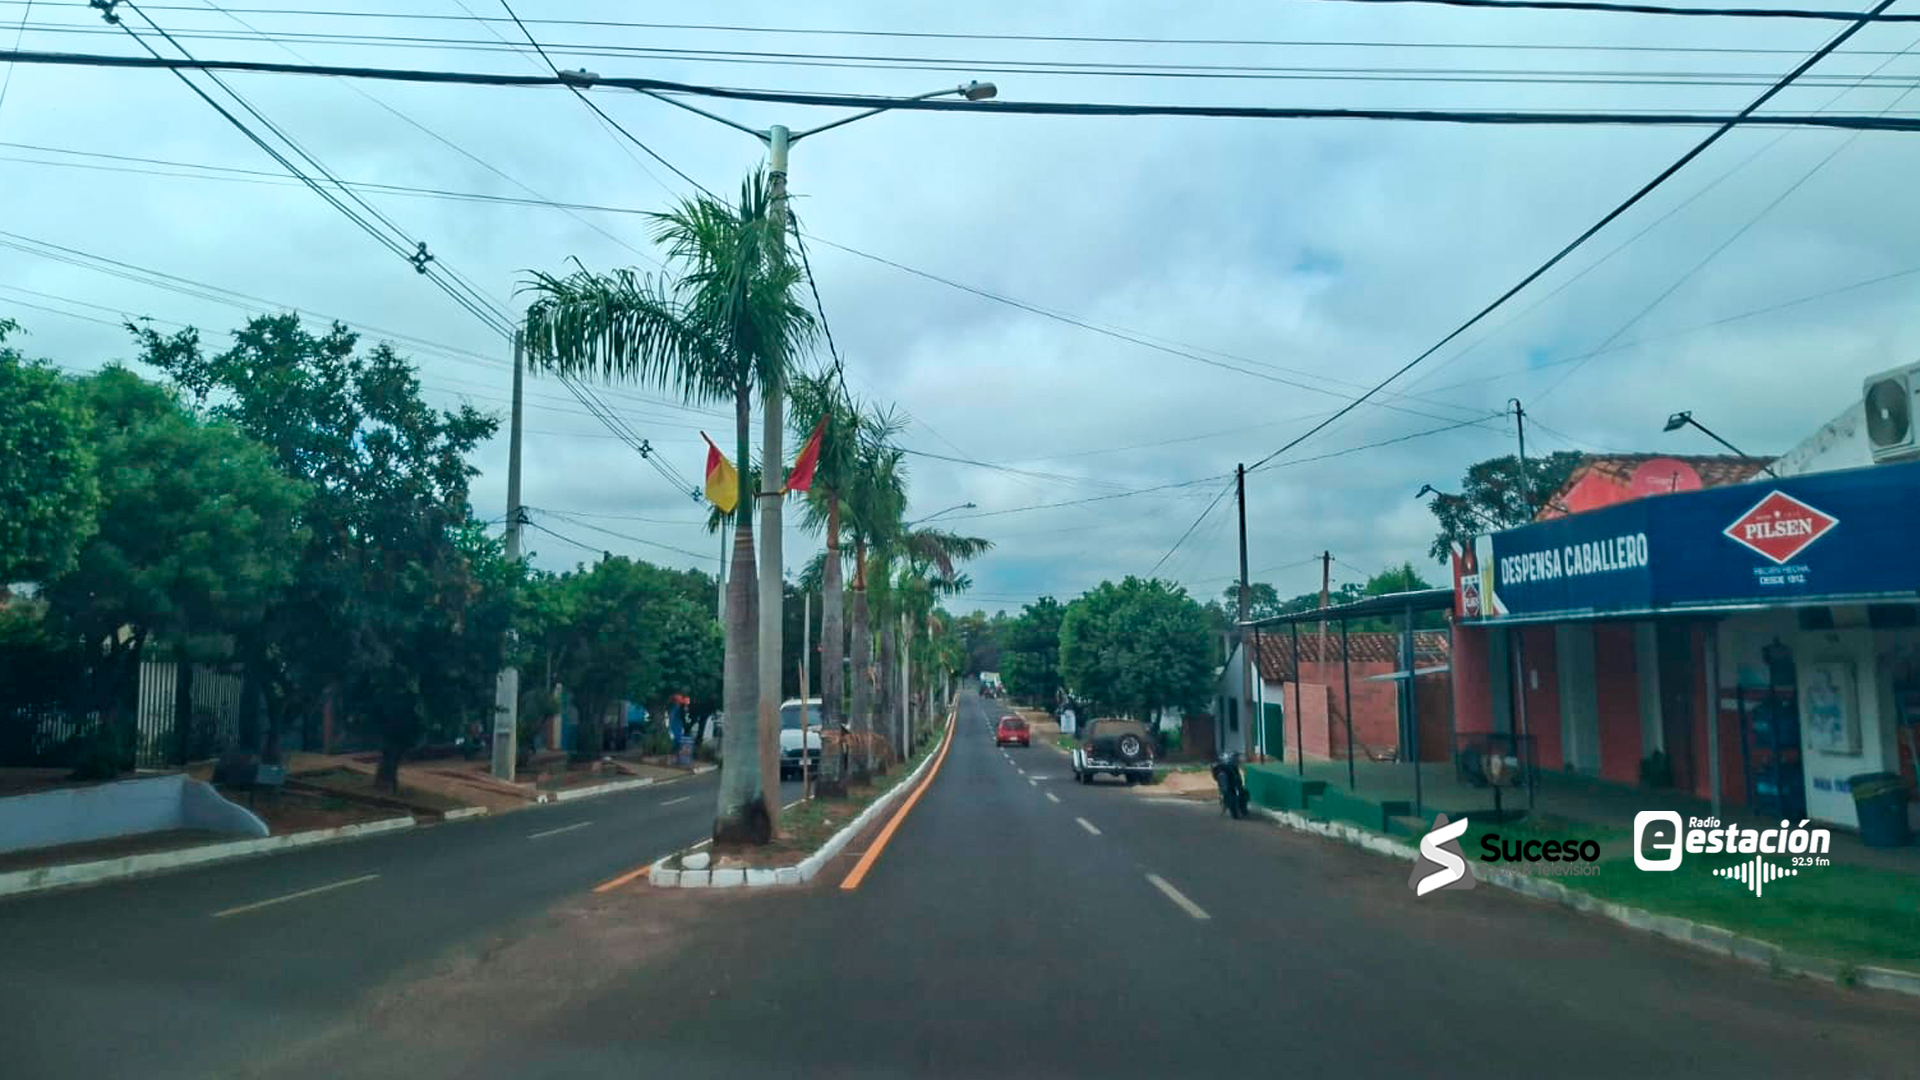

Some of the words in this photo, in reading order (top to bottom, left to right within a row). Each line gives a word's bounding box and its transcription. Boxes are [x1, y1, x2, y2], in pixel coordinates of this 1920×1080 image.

[1745, 518, 1812, 539] PILSEN
[1501, 549, 1562, 584] DESPENSA
[1564, 533, 1648, 576] CABALLERO
